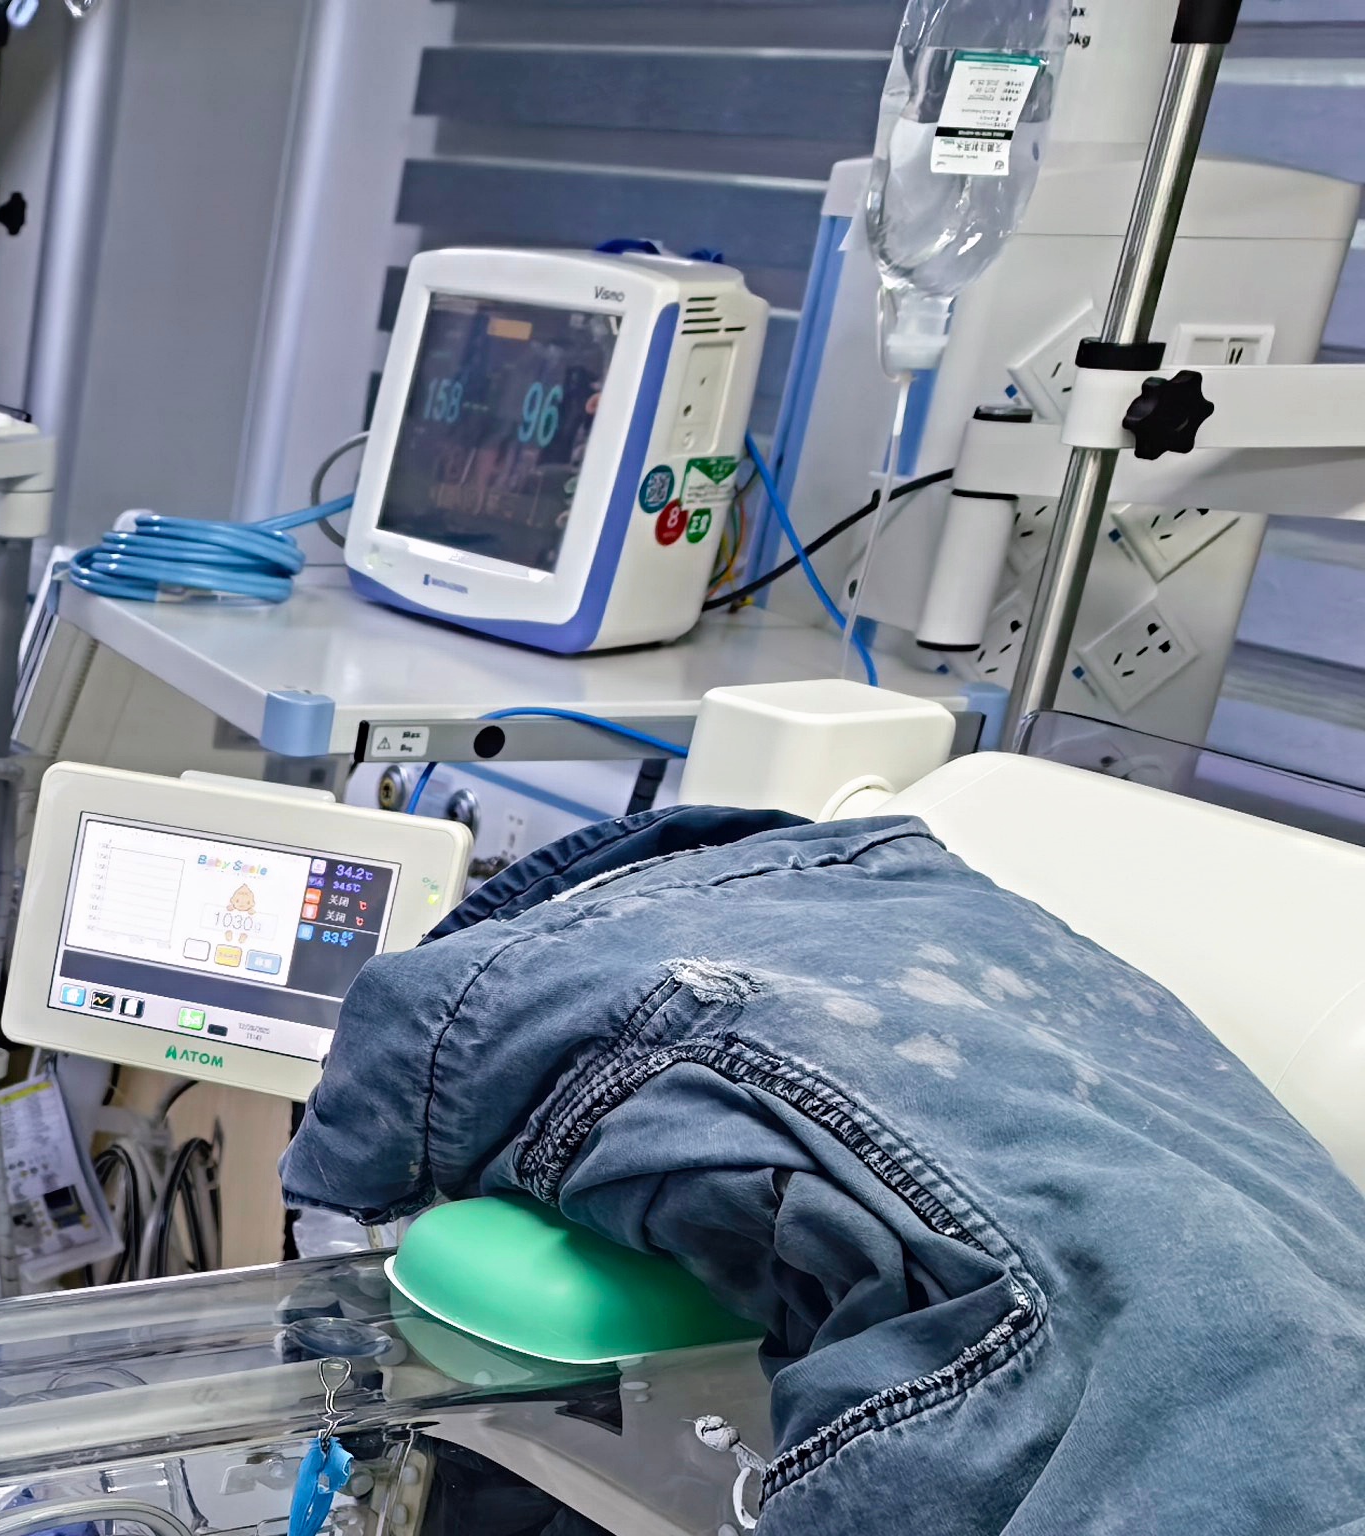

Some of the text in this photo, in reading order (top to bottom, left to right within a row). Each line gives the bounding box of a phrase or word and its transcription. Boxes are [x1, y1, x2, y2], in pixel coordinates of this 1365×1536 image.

[423, 378, 463, 423] 158
[518, 382, 563, 447] 96
[667, 506, 680, 528] 8
[197, 854, 231, 870] Baby
[328, 894, 350, 907] 关闭
[325, 910, 346, 923] 关闭
[180, 1049, 223, 1068] ATOM
